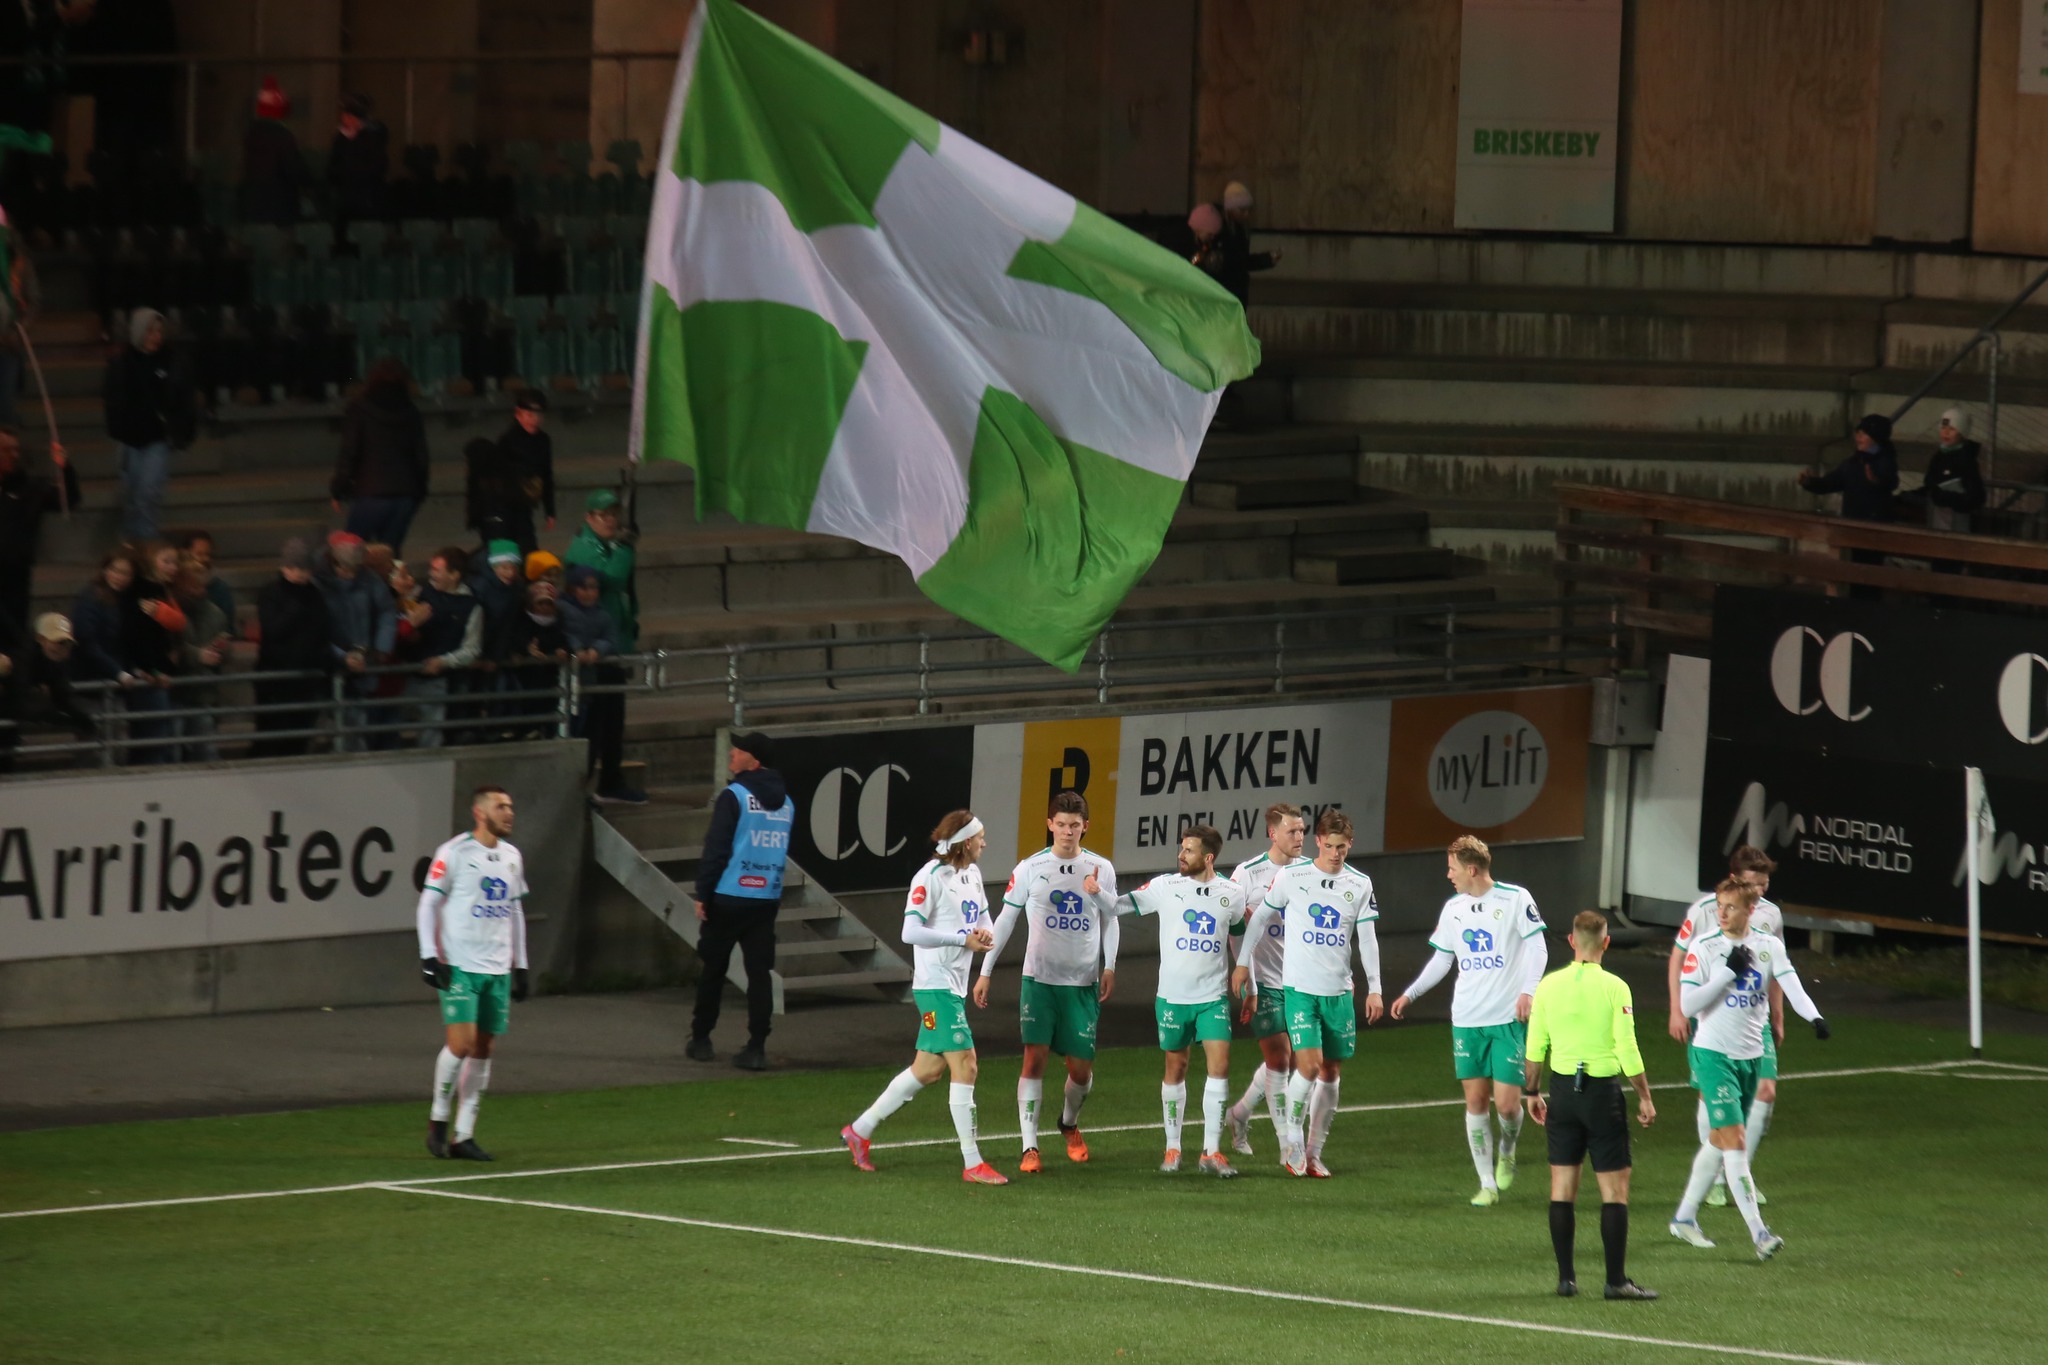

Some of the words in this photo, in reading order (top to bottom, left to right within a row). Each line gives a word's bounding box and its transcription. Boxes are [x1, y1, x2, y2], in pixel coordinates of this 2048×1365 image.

[1473, 128, 1600, 158] BRISKEBY
[1140, 728, 1321, 796] BAKKEN
[1137, 815, 1168, 848] EN
[1227, 808, 1259, 841] AV
[1815, 815, 1913, 848] NORDAL
[1800, 840, 1913, 873] RENHOLD
[471, 904, 511, 918] OBOS
[1045, 915, 1091, 932] OBOS
[1175, 937, 1222, 954] OBOS
[1302, 930, 1346, 947] OBOS
[1460, 955, 1504, 971] OBOS
[1725, 992, 1767, 1008] OBOS
